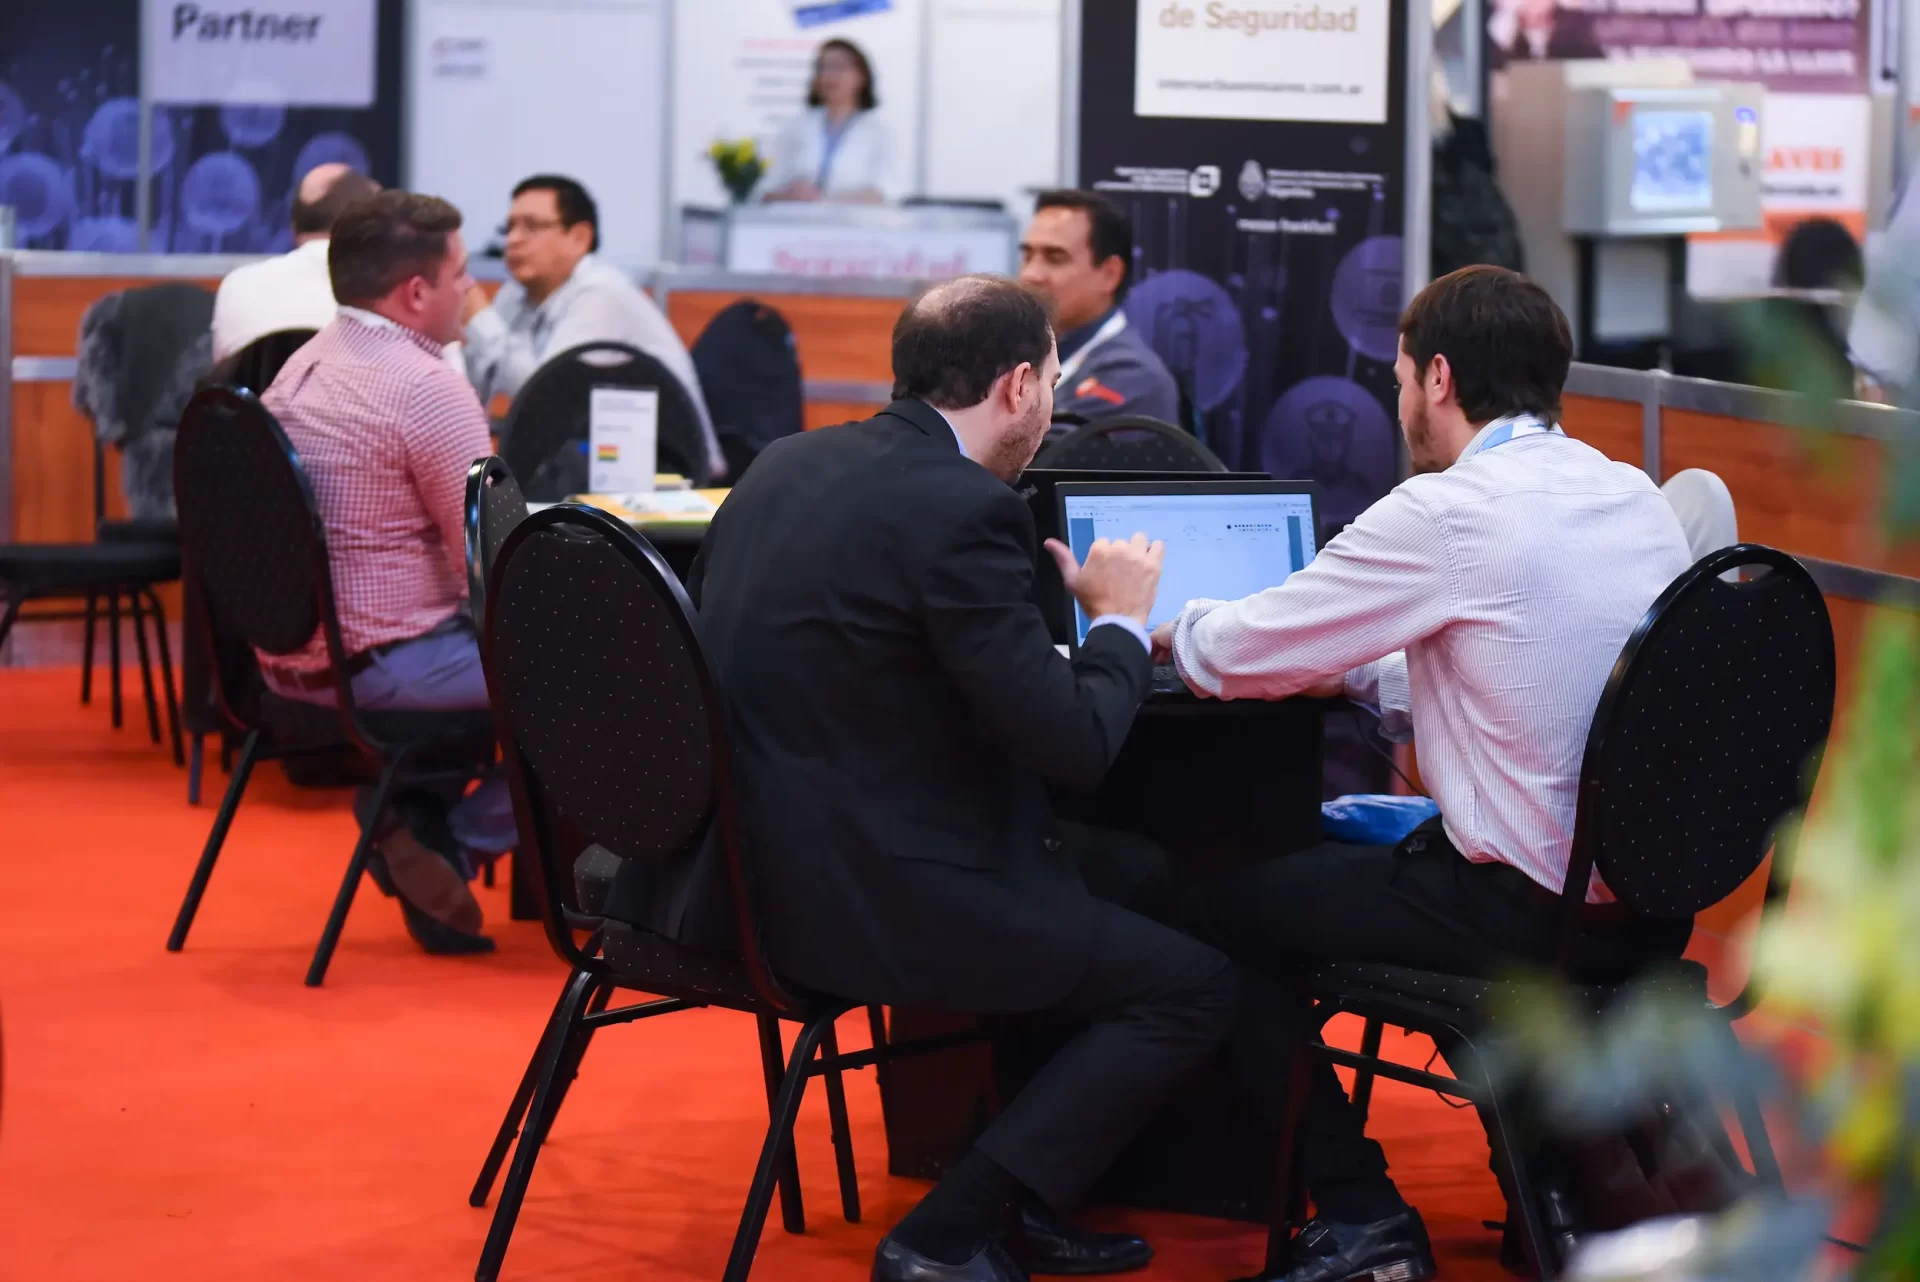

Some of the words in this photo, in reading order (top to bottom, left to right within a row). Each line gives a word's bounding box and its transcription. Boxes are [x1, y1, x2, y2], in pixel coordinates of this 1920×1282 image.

[172, 1, 324, 42] Partner
[1157, 3, 1195, 29] de
[1204, 1, 1358, 37] Seguridad
